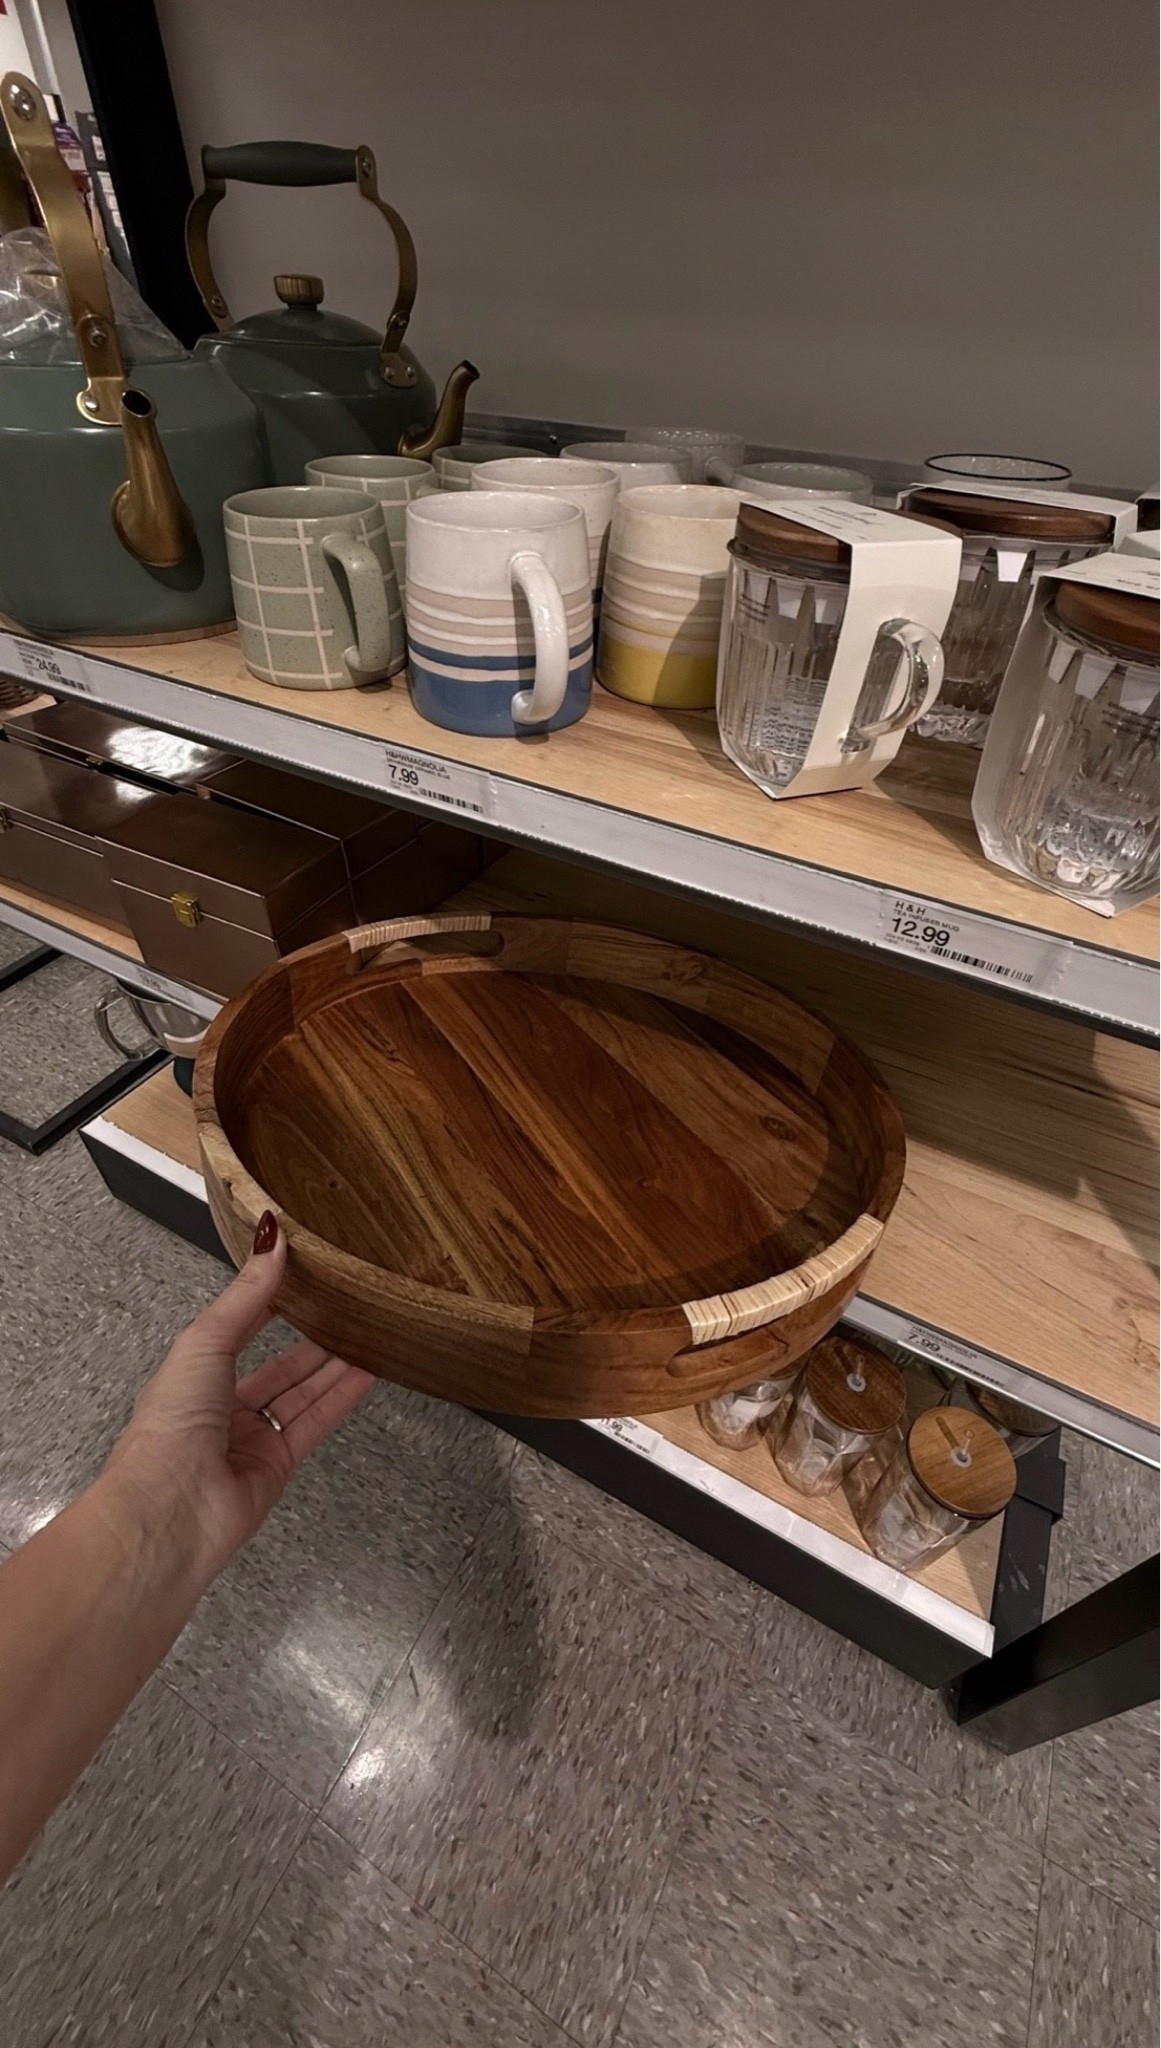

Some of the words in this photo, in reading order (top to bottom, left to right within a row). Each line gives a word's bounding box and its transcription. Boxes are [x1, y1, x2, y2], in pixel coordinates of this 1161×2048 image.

[388, 764, 418, 785] 7.99
[895, 900, 904, 909] H
[906, 904, 913, 913] &
[916, 907, 926, 916] H
[893, 908, 907, 919] TEA
[908, 912, 941, 926] INFUSER
[942, 921, 960, 933] MUG
[892, 917, 950, 947] 12.99
[908, 1333, 941, 1352] 7.99
